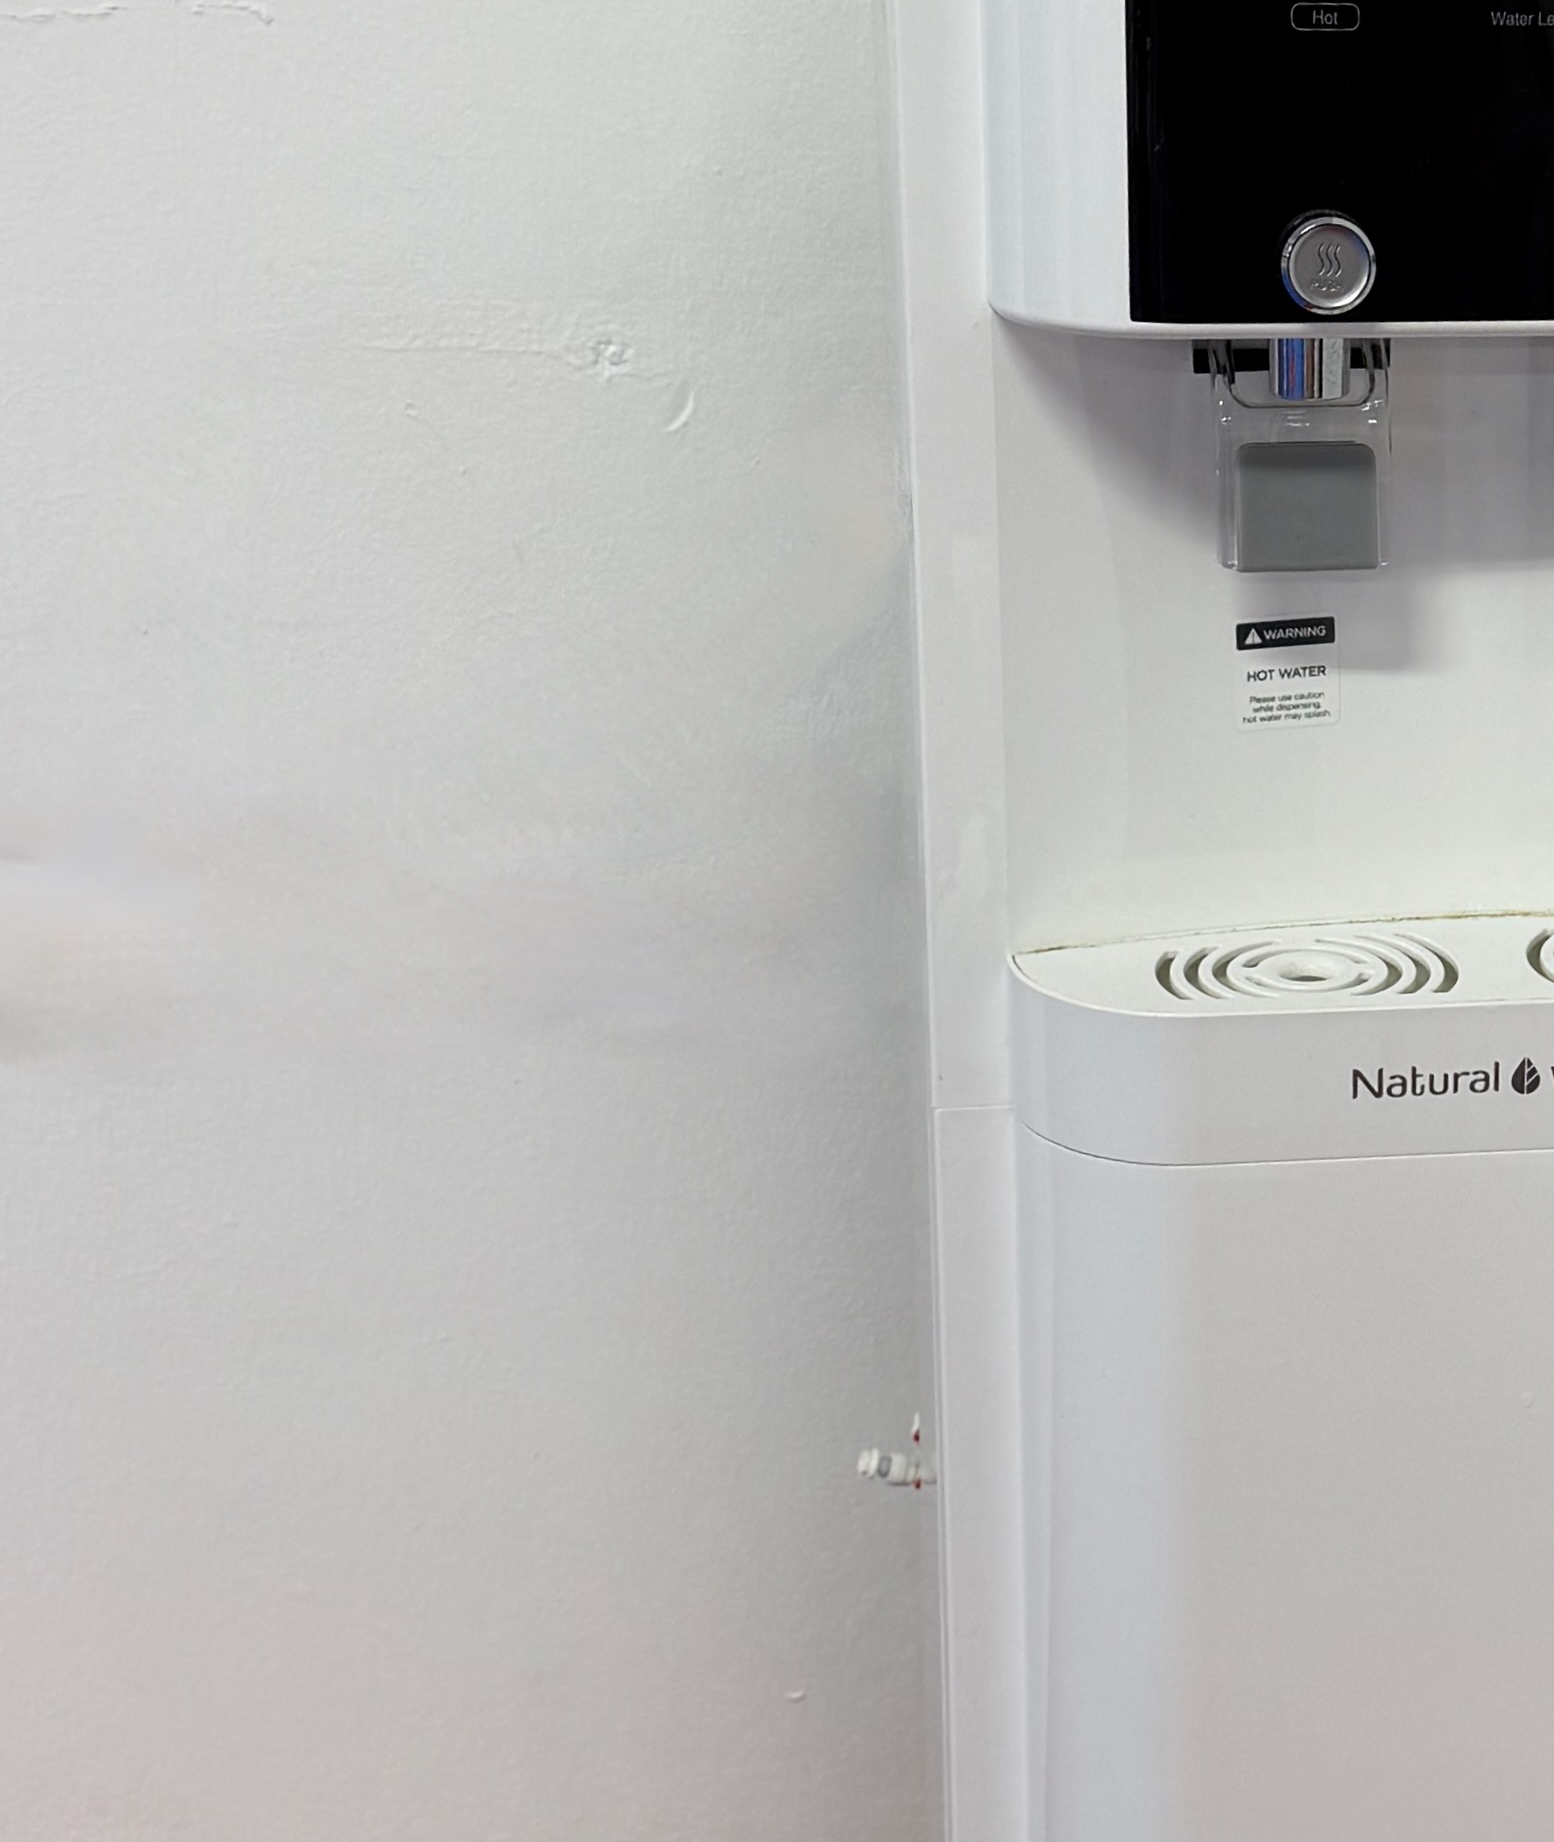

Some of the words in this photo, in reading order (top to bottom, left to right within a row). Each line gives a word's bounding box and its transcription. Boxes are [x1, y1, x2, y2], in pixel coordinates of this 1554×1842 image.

[1312, 9, 1338, 25] Hot
[1490, 10, 1535, 26] Water
[1263, 625, 1327, 640] WARNING
[1247, 669, 1275, 682] HOT
[1278, 665, 1327, 679] WATER
[1352, 1060, 1501, 1100] Natural
